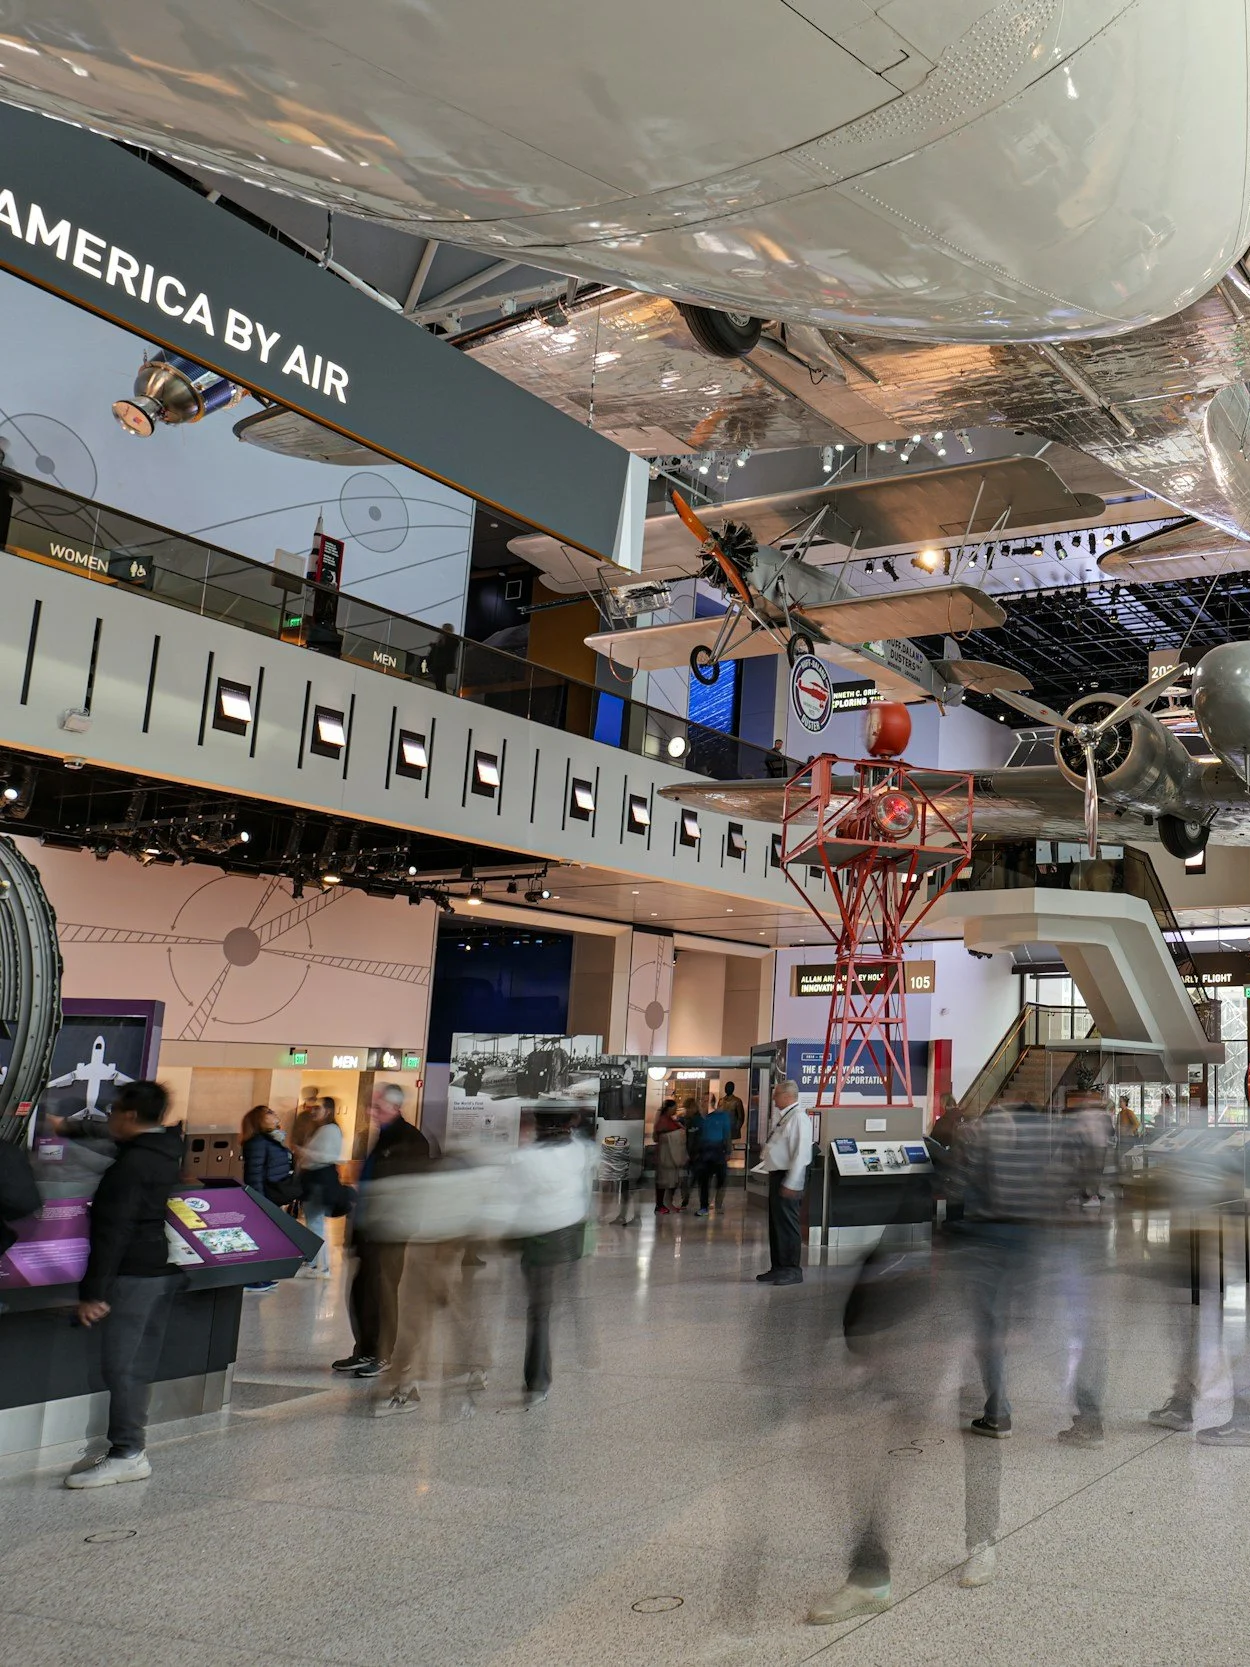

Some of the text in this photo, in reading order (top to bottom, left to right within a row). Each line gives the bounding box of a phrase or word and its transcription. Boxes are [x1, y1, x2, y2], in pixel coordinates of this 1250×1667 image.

[0, 188, 349, 405] AMERICA BY AIR
[50, 543, 109, 573] WOMEN
[373, 651, 397, 668] MEN
[890, 649, 916, 671] DUSTERS
[801, 975, 823, 983] ALLAN
[910, 976, 931, 989] 105
[1180, 973, 1233, 983] ARLY FLIGHT
[332, 1055, 359, 1068] MEN
[802, 1065, 816, 1074] THE
[801, 1076, 812, 1085] OF
